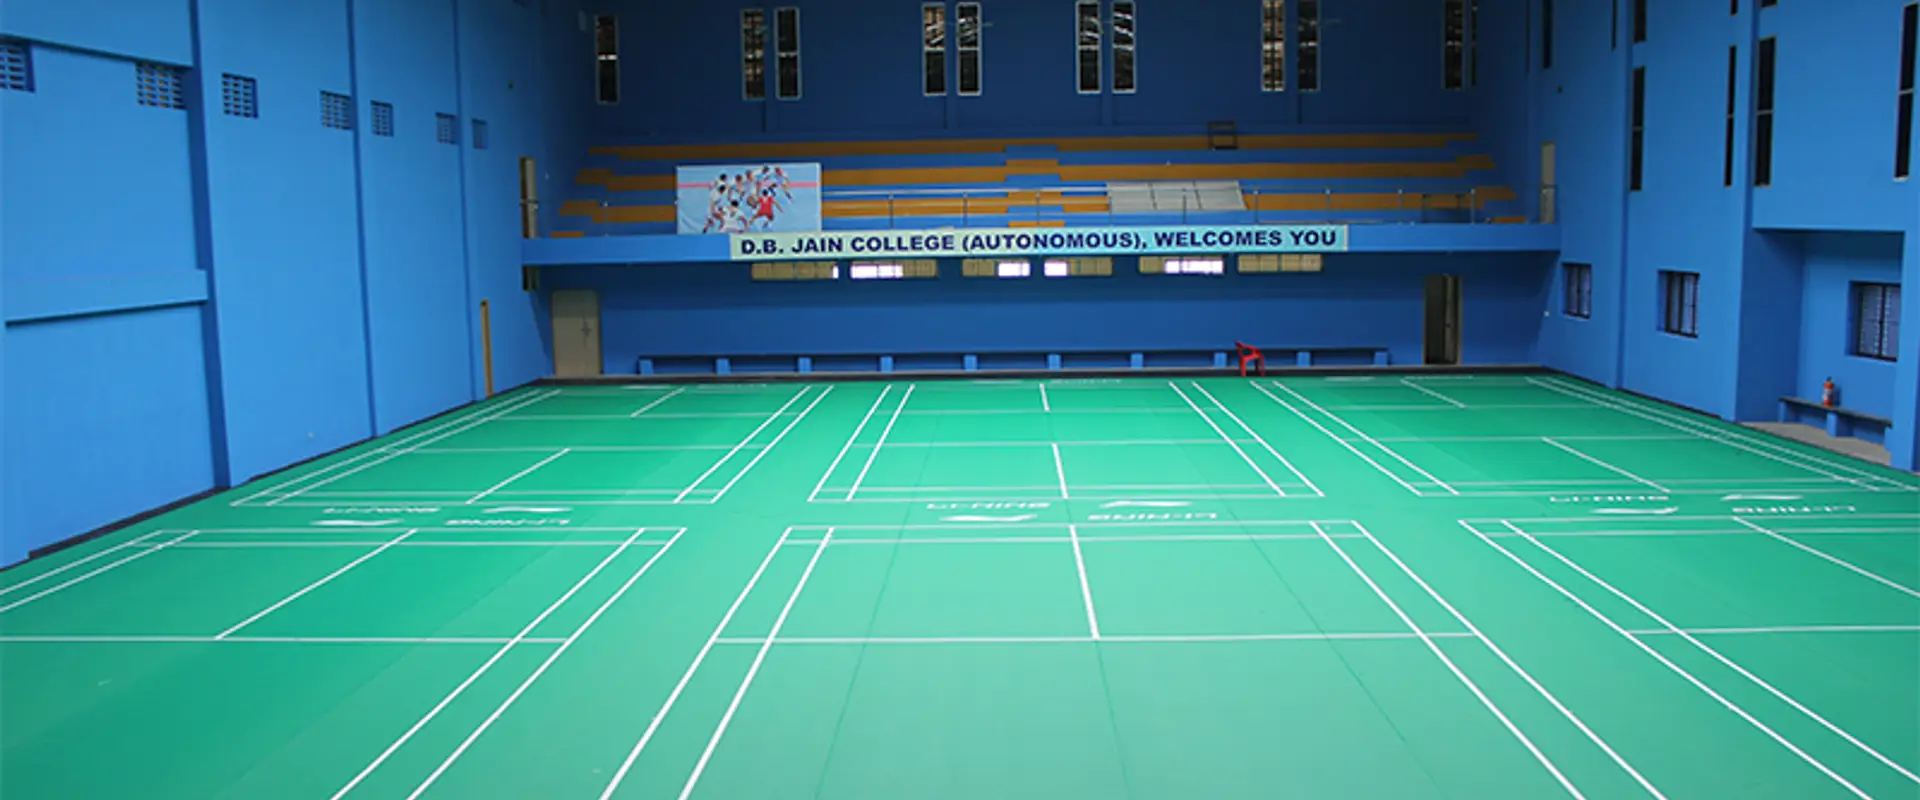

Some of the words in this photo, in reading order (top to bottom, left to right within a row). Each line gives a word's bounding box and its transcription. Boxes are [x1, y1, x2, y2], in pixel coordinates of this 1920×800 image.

[741, 239, 784, 254] D.B.
[792, 237, 843, 254] JAIN
[851, 234, 954, 252] COLLEGE
[962, 231, 1147, 252] (AUTONOMOUS),
[1154, 230, 1282, 248] WELCOMES
[1289, 229, 1337, 246] YOU
